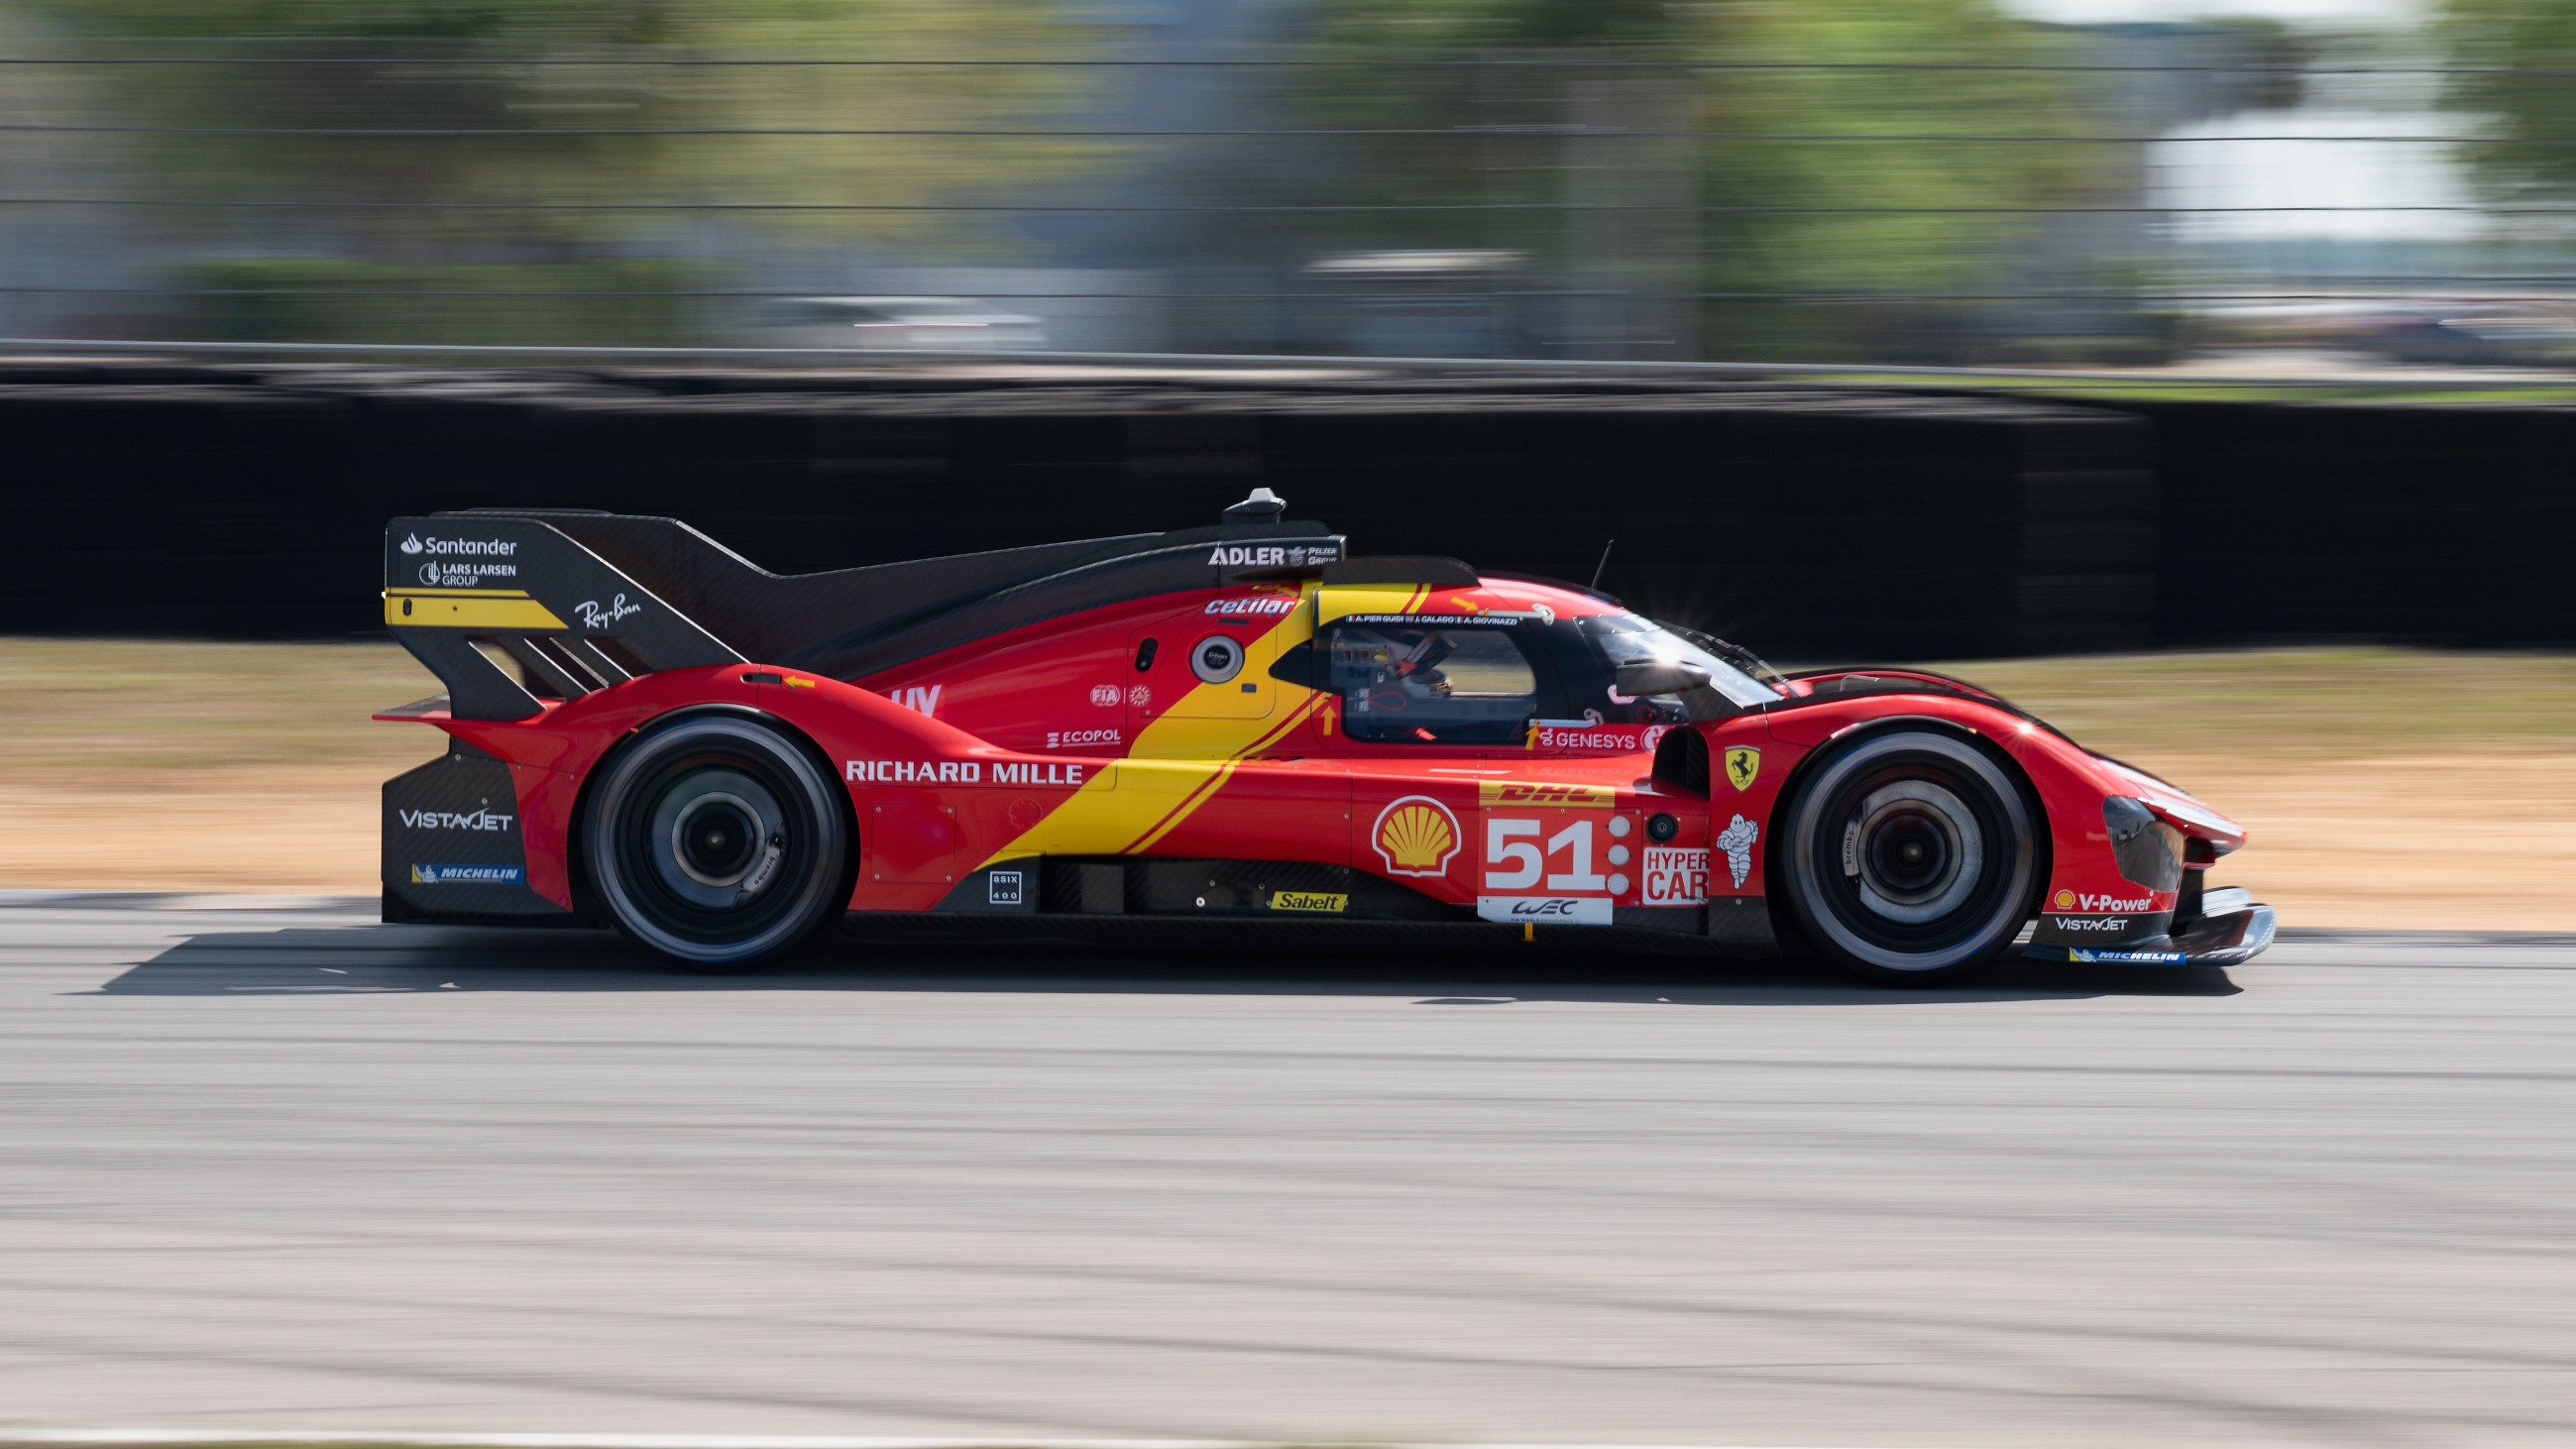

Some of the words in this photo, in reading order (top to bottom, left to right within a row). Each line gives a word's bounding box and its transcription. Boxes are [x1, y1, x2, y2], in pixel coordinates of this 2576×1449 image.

[425, 537, 517, 555] Santander
[1208, 547, 1286, 566] ADLER
[442, 563, 471, 575] LARS
[473, 564, 516, 577] LARSEN
[442, 575, 478, 587] GROUP
[575, 593, 641, 629] Ray-Ban
[1091, 689, 1118, 703] FIA
[1063, 729, 1121, 743] ECOPOL
[1556, 732, 1635, 750] GENESYS
[846, 760, 980, 782] RICHARD
[992, 763, 1083, 785] MILLE
[1498, 784, 1599, 803] DHL
[1485, 818, 1606, 890] 51
[1846, 830, 1854, 865] brembo
[1647, 851, 1710, 869] HYPER
[441, 867, 517, 879] MICHELIN
[754, 856, 777, 885] brembo
[1646, 870, 1709, 901] CAR
[1280, 893, 1339, 910] Sabelt
[1512, 899, 1579, 915] WEC
[2078, 893, 2152, 912] V-Power
[2098, 951, 2181, 961] MICHELIN
